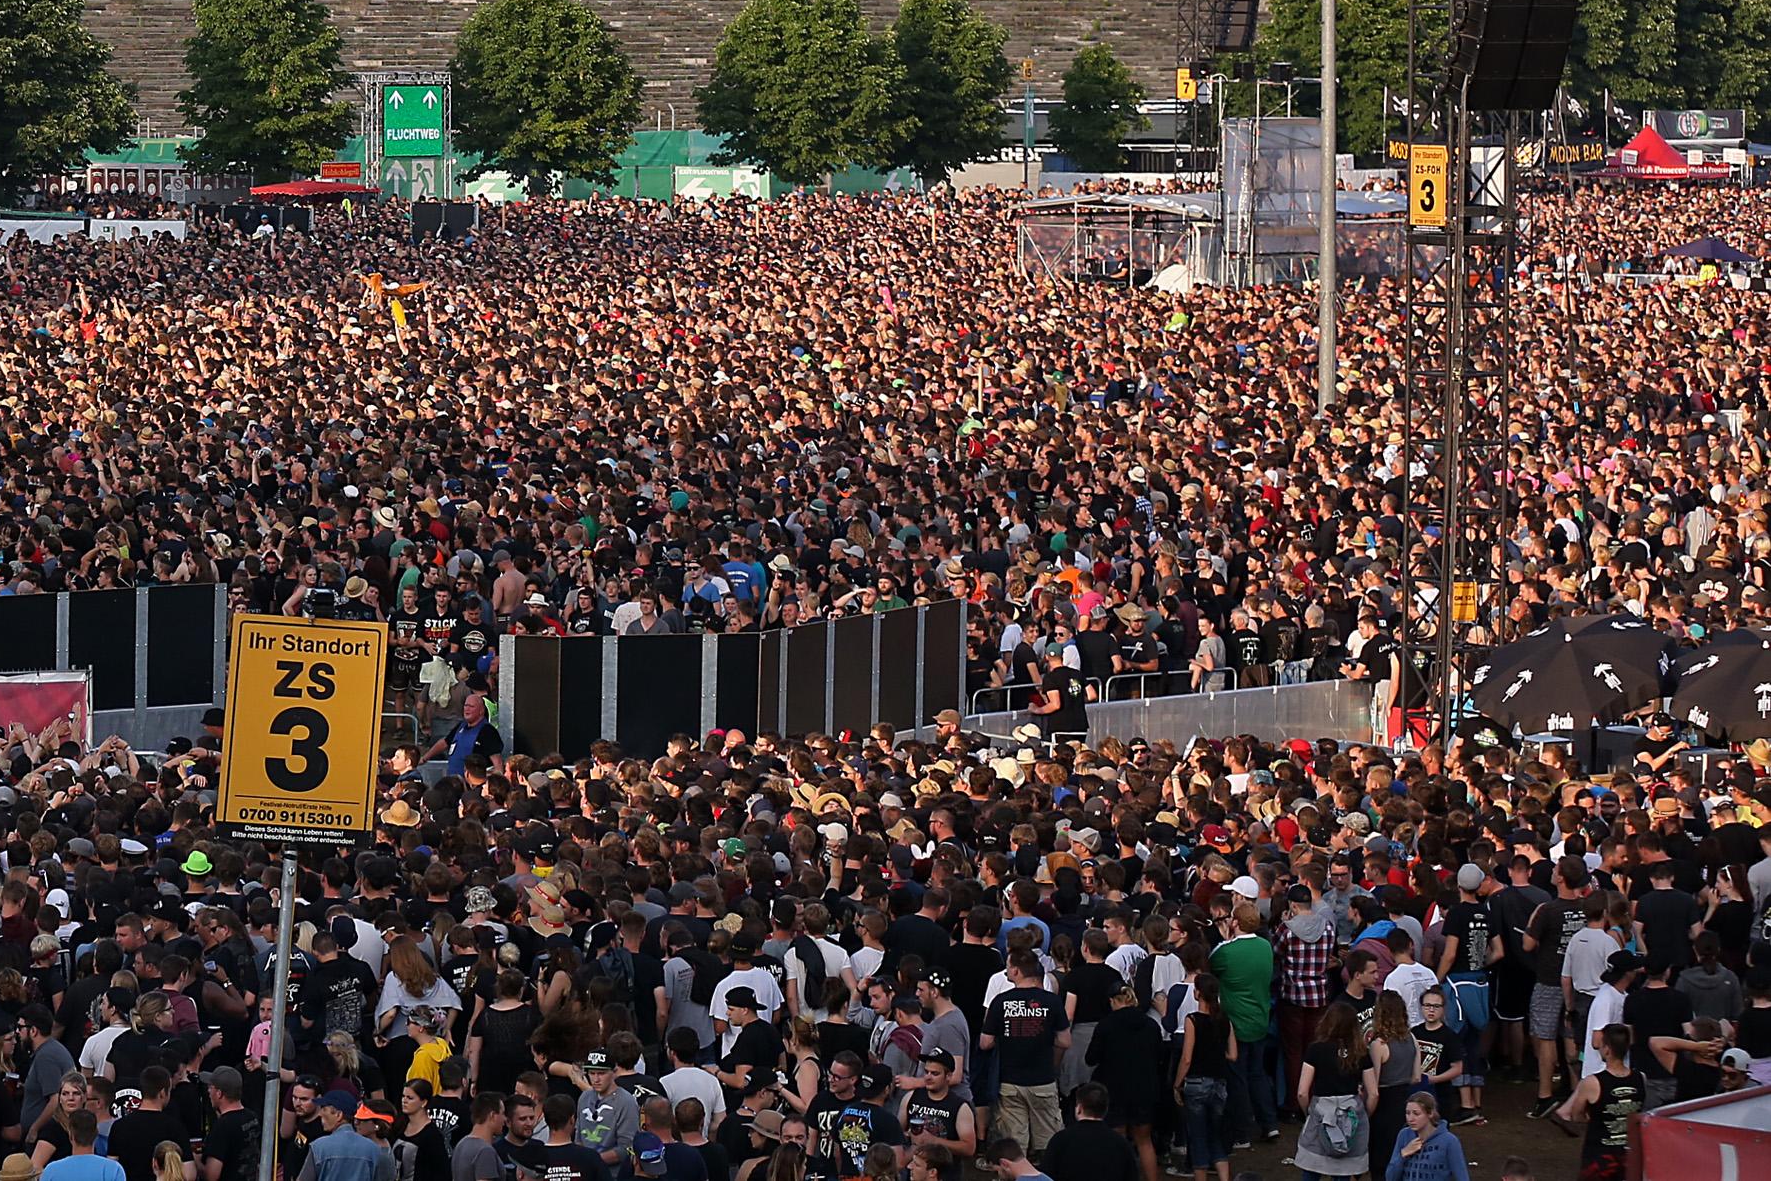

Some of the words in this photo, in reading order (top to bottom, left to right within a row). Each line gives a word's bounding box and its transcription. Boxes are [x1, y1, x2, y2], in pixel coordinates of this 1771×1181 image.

[1183, 82, 1190, 94] 7
[386, 128, 440, 141] FLUCHTWEG
[1549, 144, 1580, 164] MOON
[1583, 143, 1604, 161] BAR
[1415, 165, 1441, 174] ZS-FOH
[1654, 165, 1687, 175] Prosecco
[1420, 179, 1435, 213] 3
[425, 619, 458, 628] STICK
[249, 631, 276, 650] Ihr
[282, 633, 370, 657] Standort
[274, 660, 335, 700] ZS
[264, 706, 330, 793] 3
[239, 808, 276, 821] 0700
[279, 810, 353, 826] 91153010
[244, 824, 265, 832] Dieses
[287, 827, 303, 835] kann
[231, 830, 246, 838] Bitte
[319, 837, 356, 845] entwenden!
[1003, 1000, 1026, 1010] RISE
[1003, 1008, 1050, 1018] AGAINST
